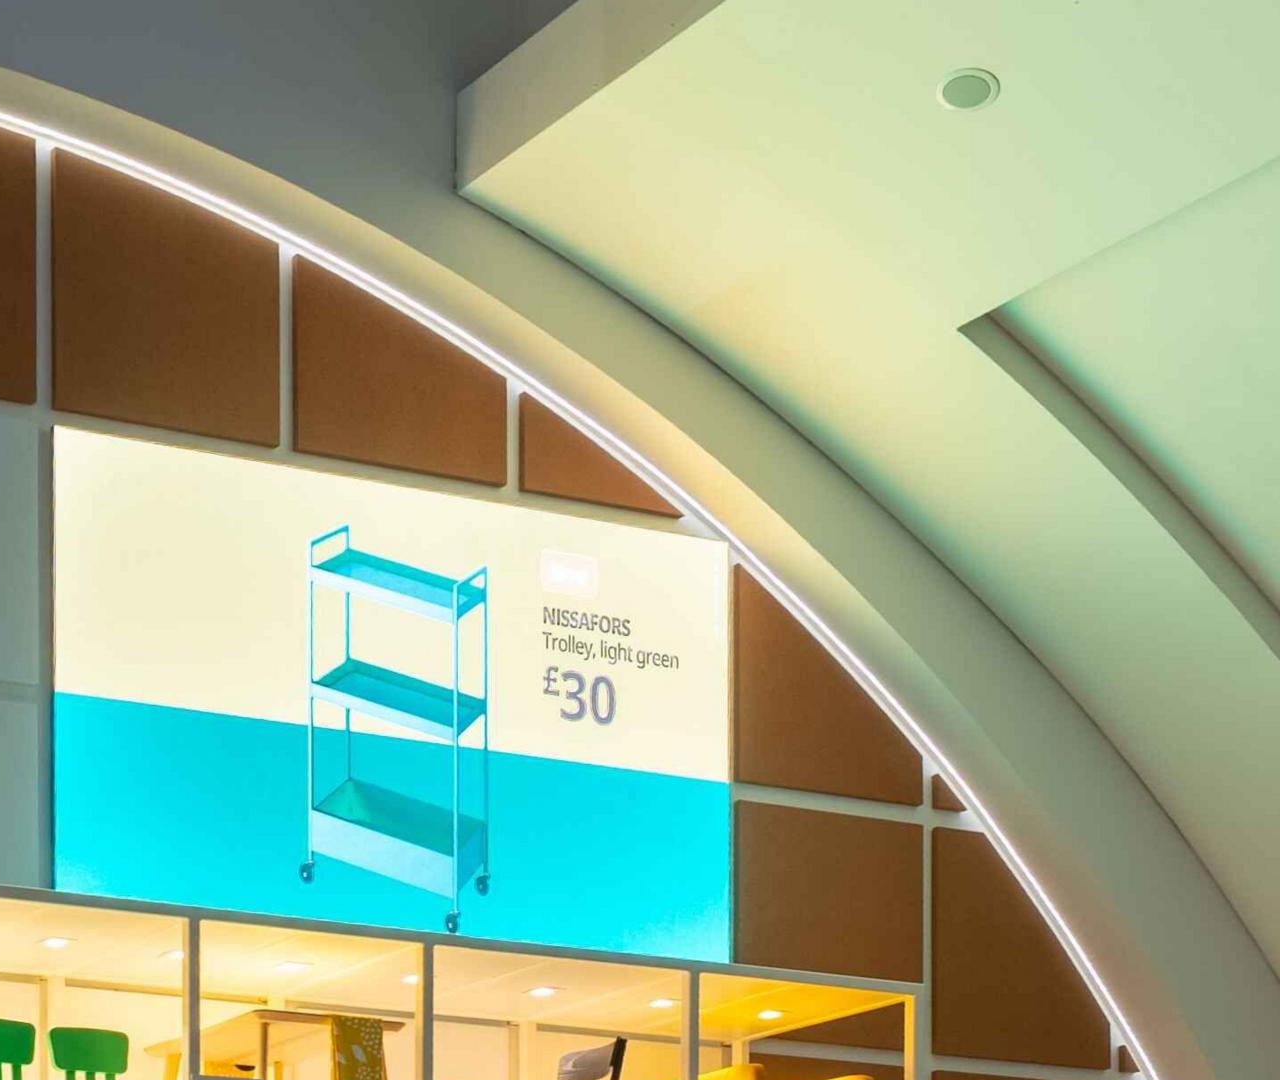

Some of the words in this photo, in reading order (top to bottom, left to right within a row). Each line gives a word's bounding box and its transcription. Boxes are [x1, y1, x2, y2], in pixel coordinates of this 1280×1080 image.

[542, 605, 632, 637] NISSAFORS
[542, 631, 597, 661] Trolley,
[600, 639, 634, 665] light
[636, 649, 680, 670] green
[542, 665, 617, 727] £30
